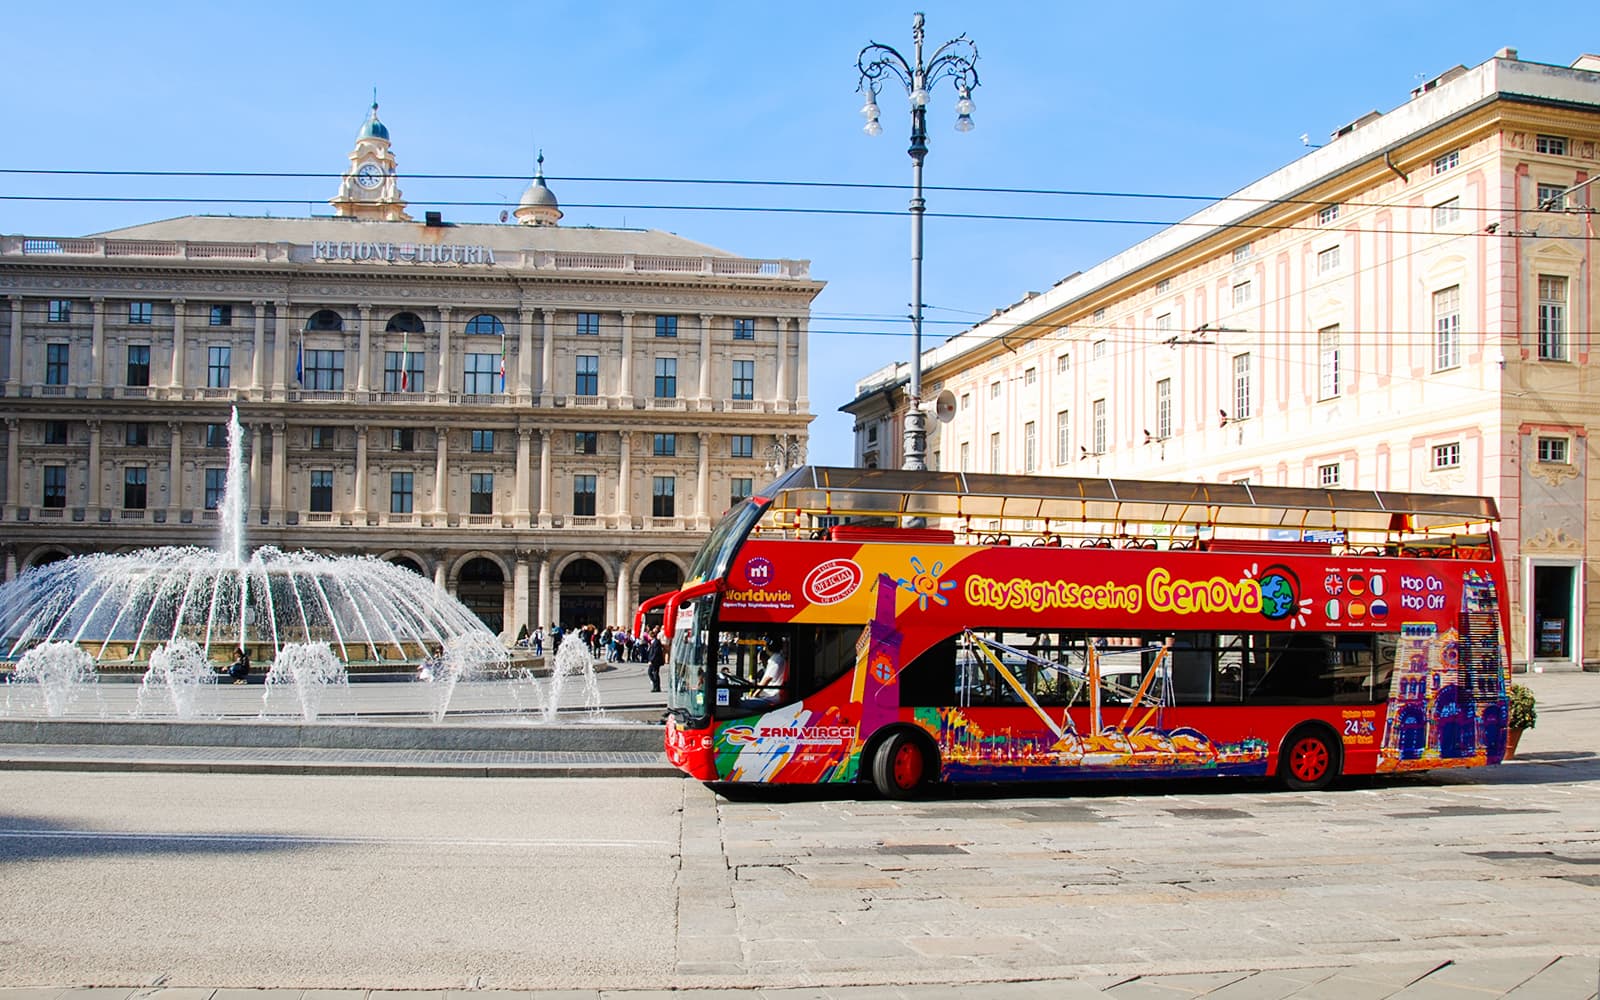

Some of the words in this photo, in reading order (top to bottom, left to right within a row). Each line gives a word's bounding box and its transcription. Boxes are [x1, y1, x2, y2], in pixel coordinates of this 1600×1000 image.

[312, 240, 395, 262] REGIONE
[418, 243, 496, 265] LIGURIA
[814, 569, 851, 592] OFFICIAL
[1402, 577, 1423, 592] Hop
[1427, 576, 1443, 590] On
[964, 574, 1142, 615] CitySightseeing
[1145, 567, 1263, 615] Genova
[1402, 595, 1424, 610] Hop
[1428, 595, 1446, 609] Off
[760, 727, 798, 737] ZANI
[801, 727, 855, 738] VIAGGI
[1344, 720, 1359, 735] 24
